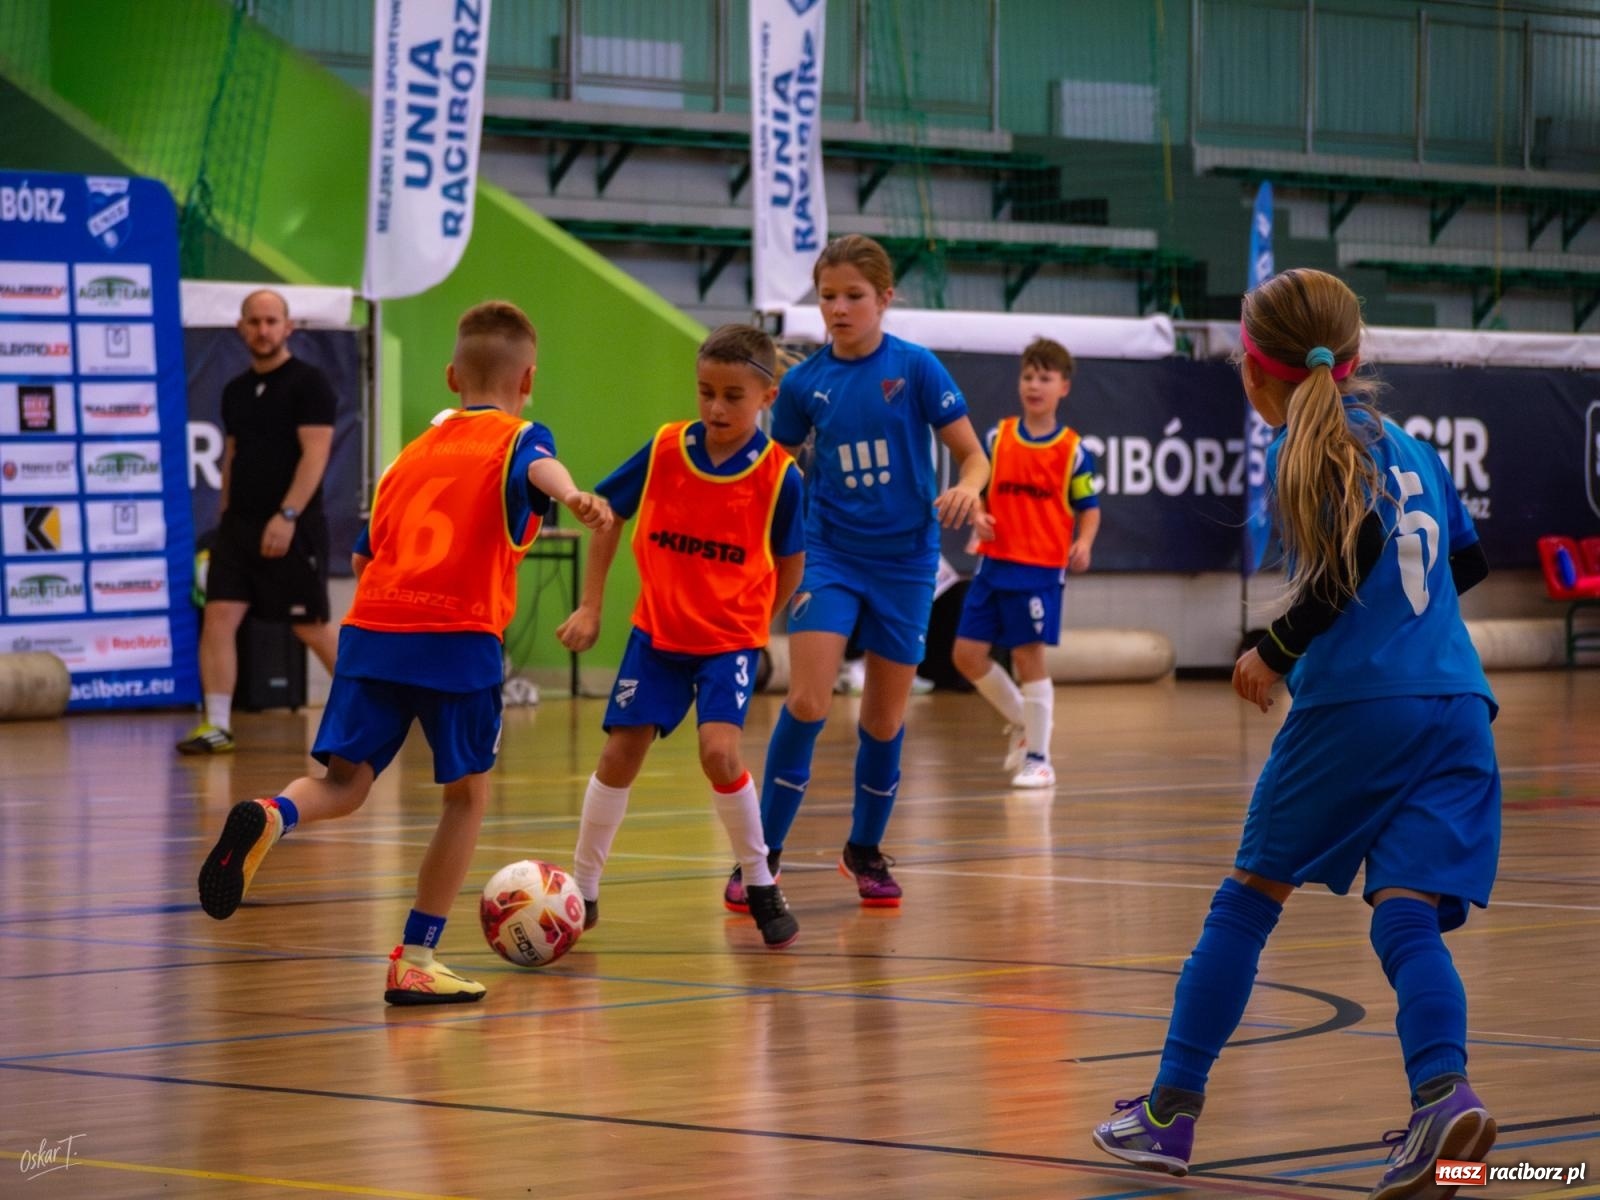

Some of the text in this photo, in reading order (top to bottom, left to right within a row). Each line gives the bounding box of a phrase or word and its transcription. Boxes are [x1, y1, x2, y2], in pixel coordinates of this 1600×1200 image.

[382, 98, 398, 150] KLUB
[404, 38, 443, 189] UNIA
[440, 0, 482, 238] RACIBÓRZ
[771, 69, 794, 208] UNIA
[377, 154, 394, 234] MIEJSKI
[399, 477, 457, 573] 6
[735, 655, 750, 687] 3
